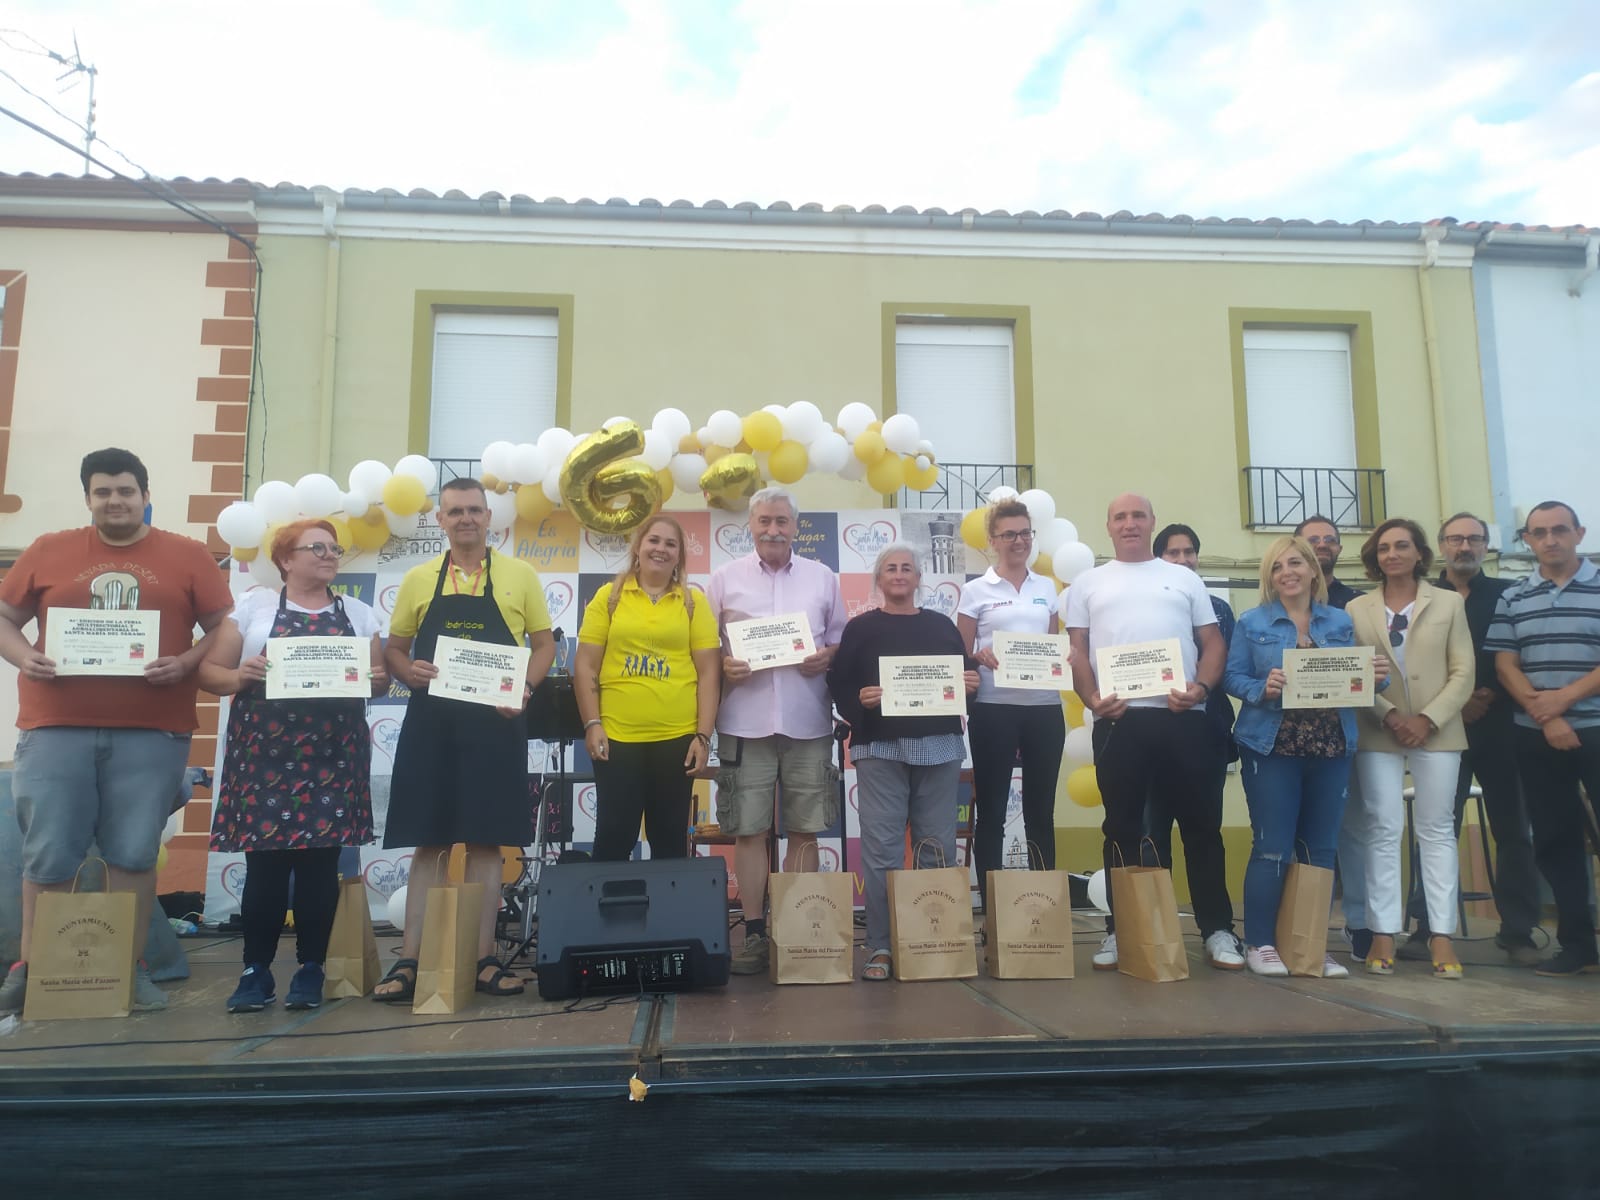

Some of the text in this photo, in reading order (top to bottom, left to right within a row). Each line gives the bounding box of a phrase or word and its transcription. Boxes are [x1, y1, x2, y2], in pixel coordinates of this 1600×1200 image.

[560, 420, 663, 534] 6
[795, 894, 837, 909] AYUNTAMIENTO
[912, 890, 956, 905] AYUNTAMIENTO
[1013, 892, 1056, 907] AYUNTAMIENTO
[57, 918, 116, 935] AYUNTAMIENTO
